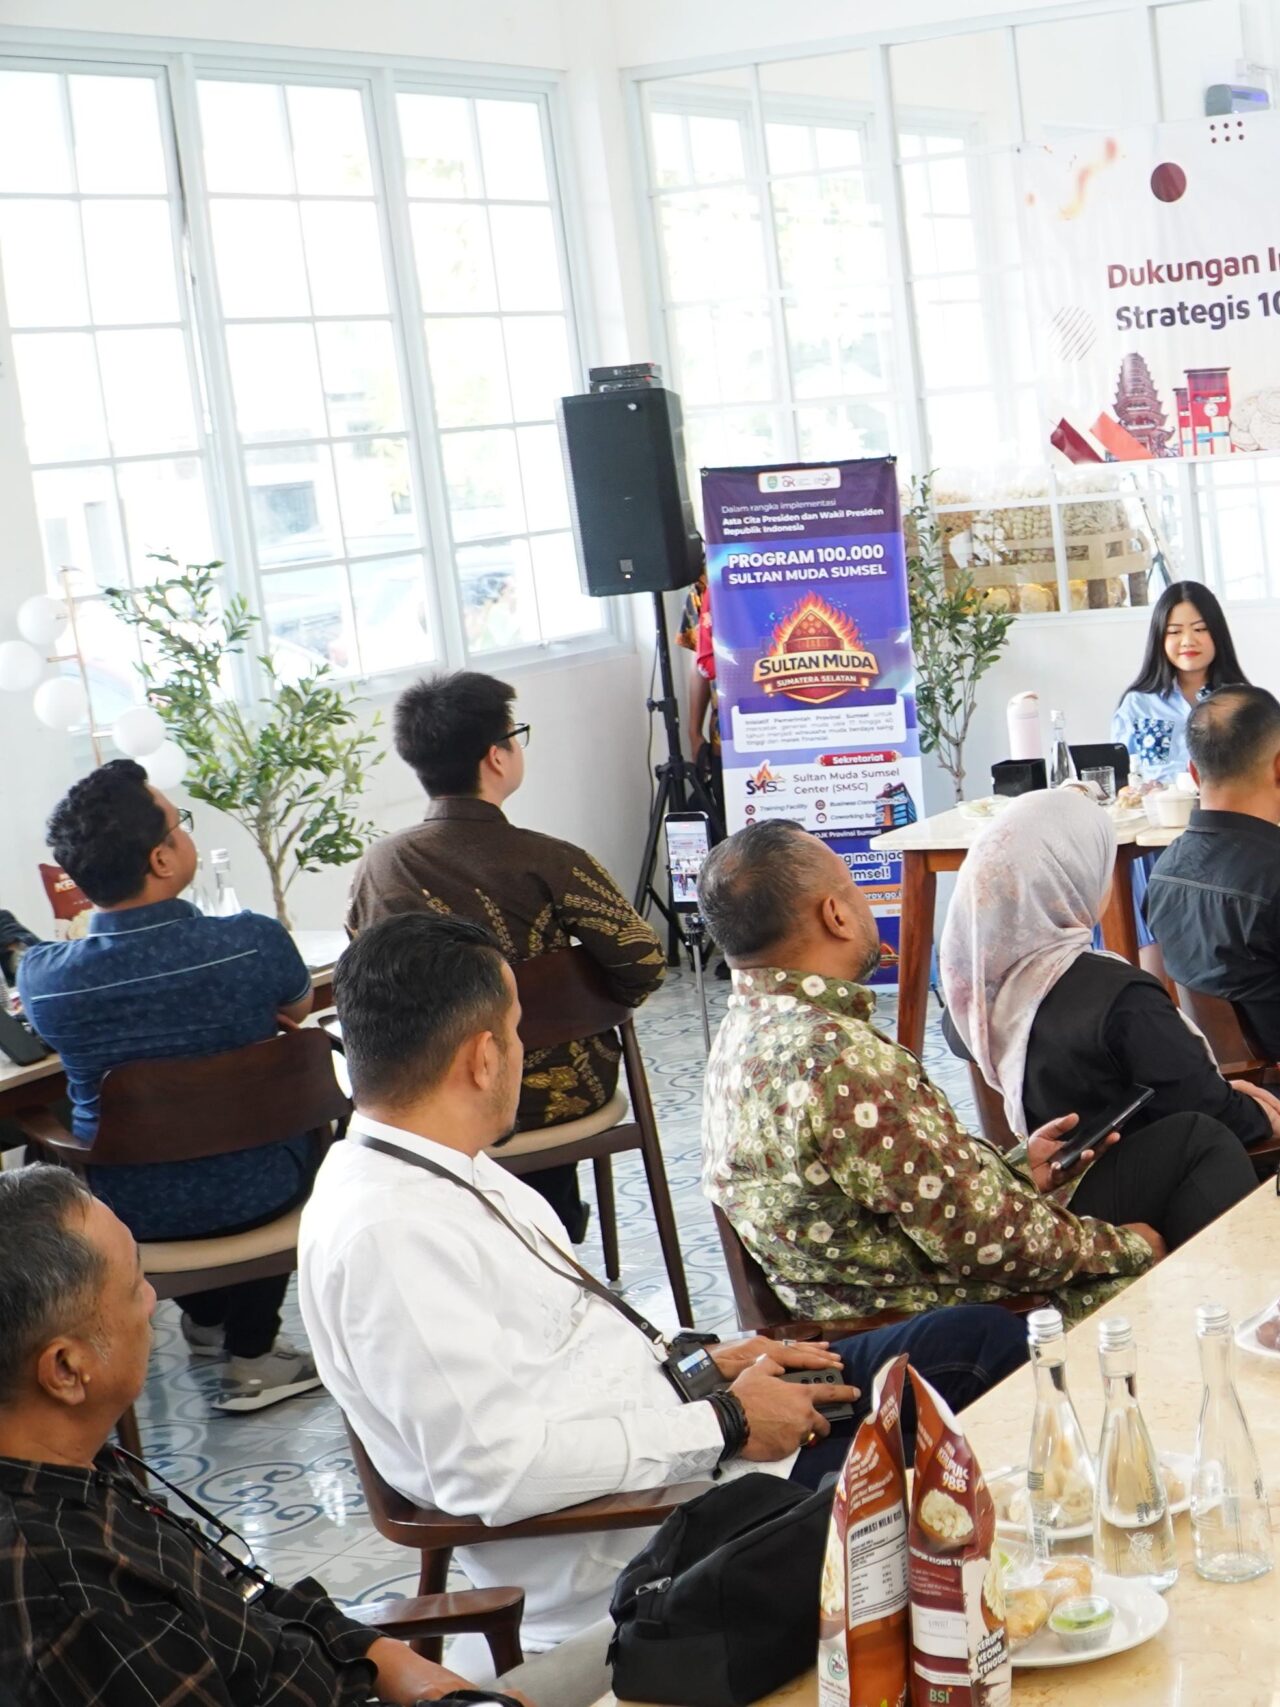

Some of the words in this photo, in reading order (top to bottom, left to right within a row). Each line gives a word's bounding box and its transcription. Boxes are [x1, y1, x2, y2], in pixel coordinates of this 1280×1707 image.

[1107, 253, 1260, 288] Dukungan
[1116, 294, 1251, 331] Strategis
[721, 504, 749, 514] Dalam
[750, 502, 779, 514] rangka
[780, 499, 837, 512] implementasi
[722, 517, 742, 526] Asta
[743, 515, 761, 525] Cita
[762, 513, 800, 524] Presiden
[801, 512, 818, 521] dan
[819, 510, 845, 519] Wakil
[846, 508, 885, 517] Presiden
[723, 525, 762, 537] Republik
[763, 523, 805, 534] Indonesia
[728, 549, 815, 569] PROGRAM
[818, 544, 885, 563] 100.000
[729, 571, 783, 585] SULTAN
[785, 569, 829, 582] MUDA
[831, 564, 887, 580] SUMSEL
[759, 656, 821, 677] SULTAN
[823, 654, 874, 670] MUDA
[776, 675, 819, 687] SUMATERA
[820, 674, 857, 683] SELATAN
[832, 753, 885, 765] Sekretariat
[793, 772, 827, 783] Sultan
[829, 769, 859, 780] Muda
[861, 767, 901, 778] Sumsel
[794, 785, 830, 795] Center
[832, 782, 869, 794] (SMSC)
[942, 1470, 967, 1494] 988
[851, 1520, 878, 1541] INFORMASI
[929, 1556, 952, 1567] KEONG
[977, 1641, 1003, 1665] KEONG
[929, 1687, 951, 1704] BSI
